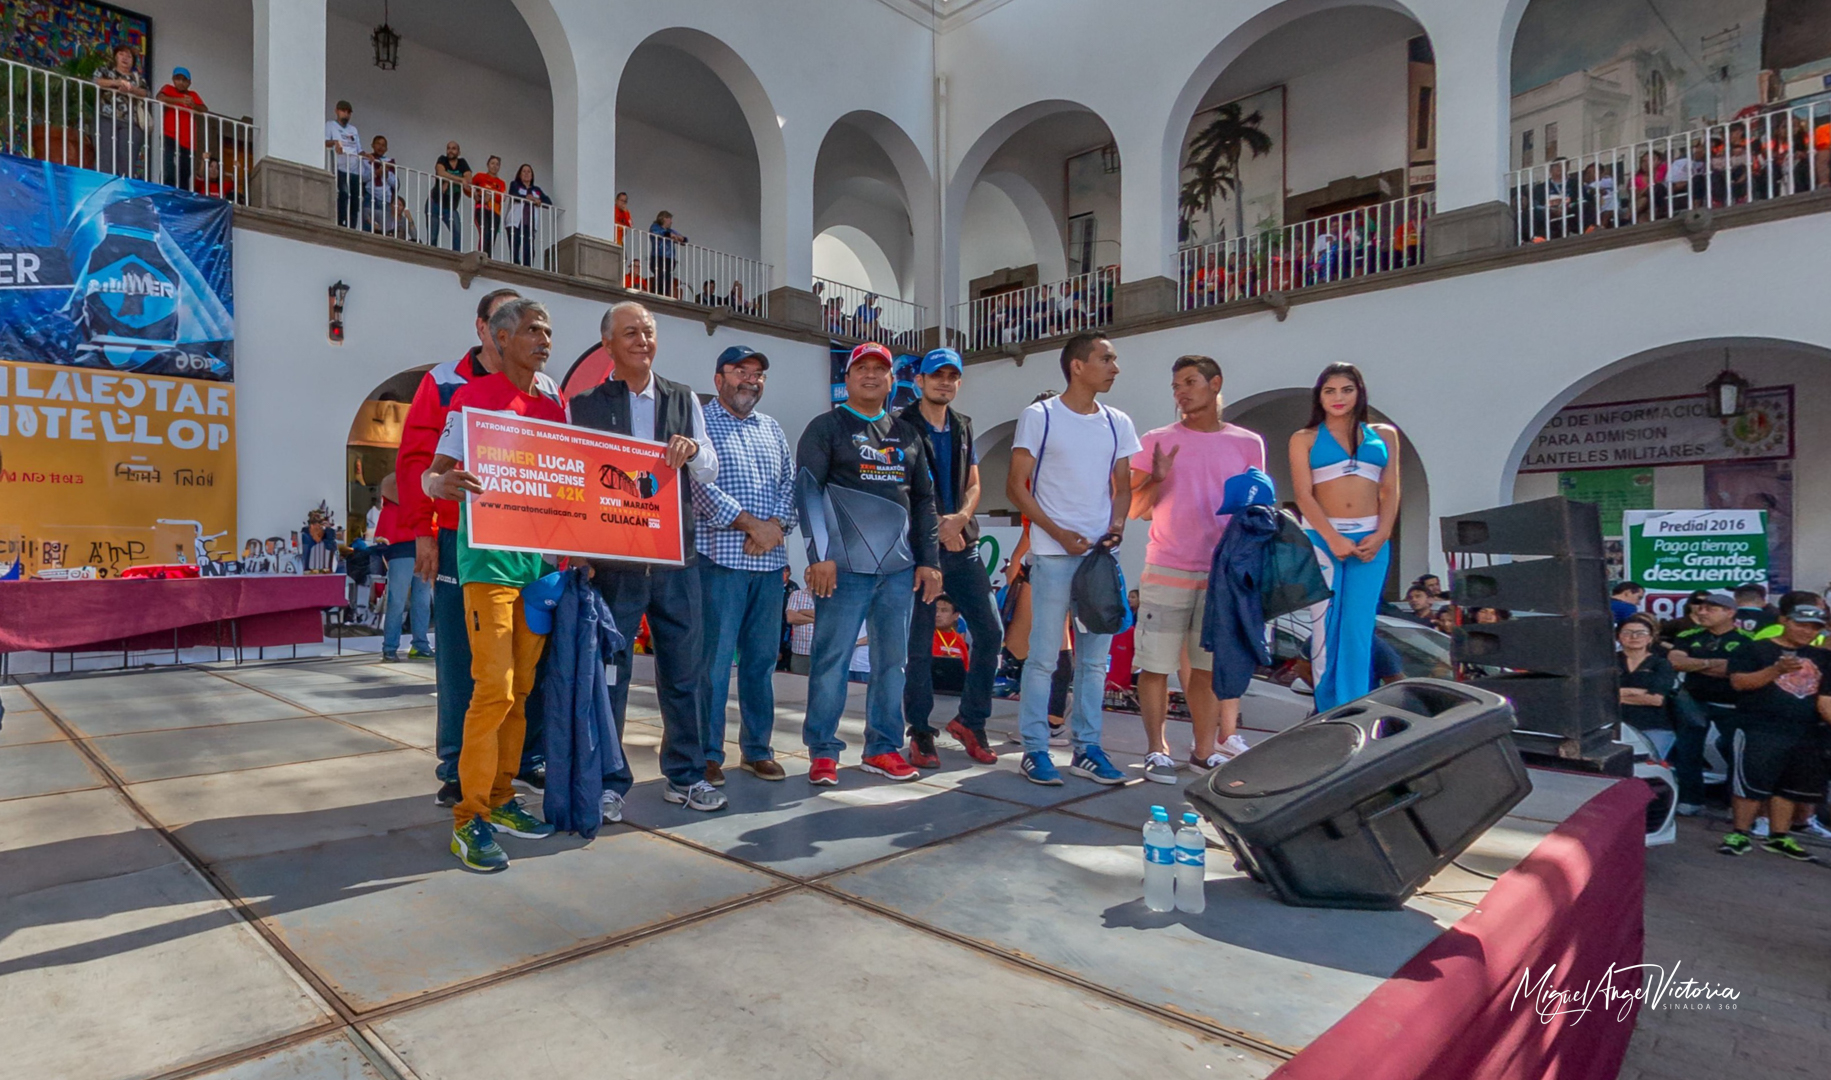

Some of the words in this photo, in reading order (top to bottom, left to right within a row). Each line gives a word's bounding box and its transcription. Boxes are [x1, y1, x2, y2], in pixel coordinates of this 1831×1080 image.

[1567, 414, 1589, 427] DE
[475, 421, 520, 434] PATRONATO
[521, 428, 535, 437] DEL
[536, 431, 570, 443] MARATÓN
[571, 437, 621, 452] INTERNACIONAL
[622, 445, 631, 453] DE
[631, 447, 660, 459] CULIACÁN
[1538, 432, 1580, 447] PARA
[476, 445, 535, 466] PRIMER
[538, 453, 585, 474] LUGAR
[477, 462, 517, 477] MEJOR
[519, 468, 585, 487] SINALOENSE
[478, 475, 552, 498] VARONIL
[556, 486, 585, 502] 42K
[480, 501, 587, 520] www.maratonculiacan.org
[599, 496, 621, 507] XXVII
[623, 499, 660, 511] MARATÓN
[600, 512, 649, 528] CULIACÁN
[1659, 519, 1708, 532] Predial
[1710, 519, 1746, 532] 2016
[1654, 538, 1689, 555] Paga
[1689, 542, 1700, 552] a
[1700, 539, 1749, 554] tiempo
[1683, 551, 1756, 566] Grandes
[1643, 563, 1767, 581] descuentos
